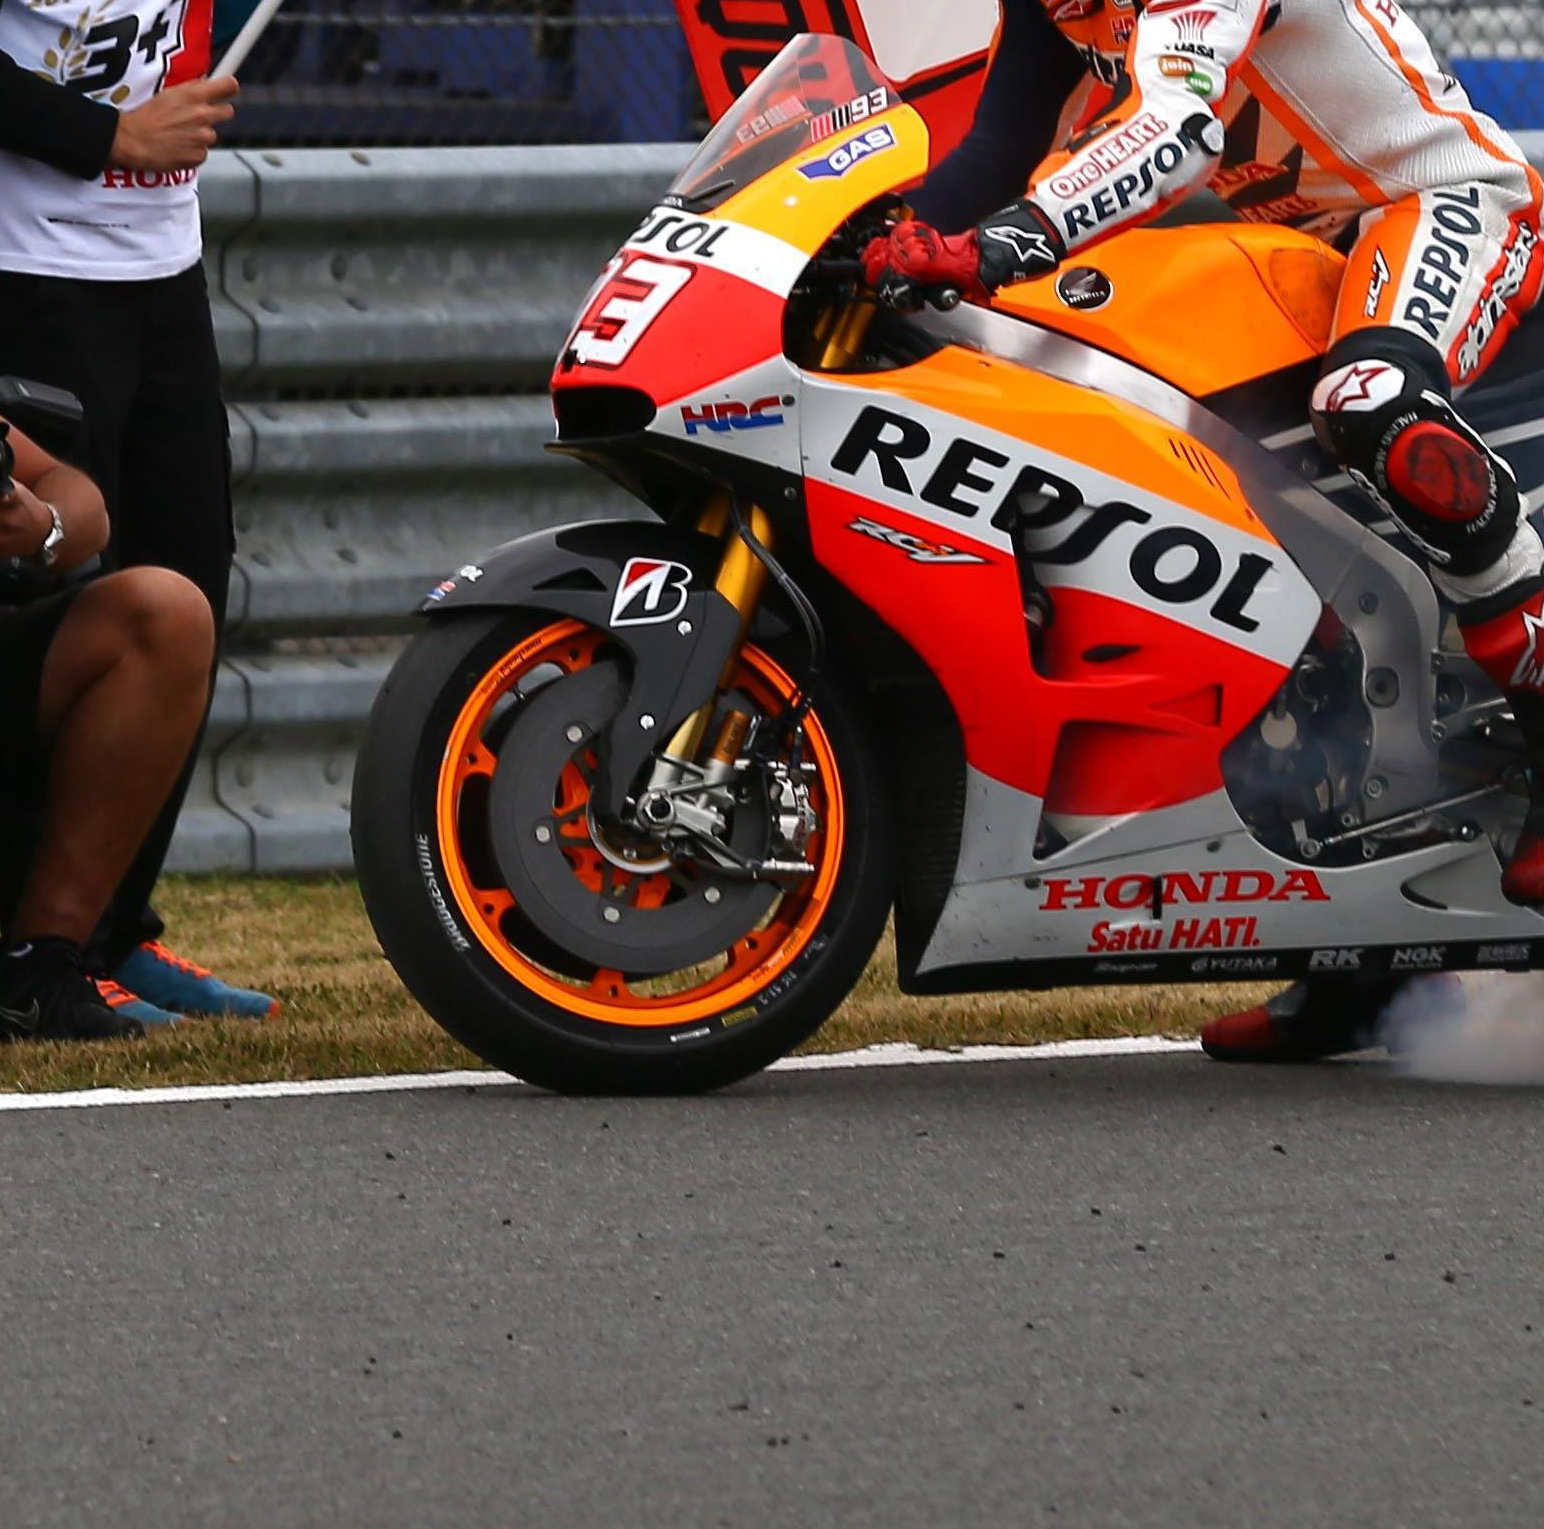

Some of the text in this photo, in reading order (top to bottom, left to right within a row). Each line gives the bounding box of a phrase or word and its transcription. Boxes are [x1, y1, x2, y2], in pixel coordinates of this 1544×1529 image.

[1165, 41, 1217, 61] UASA
[827, 127, 895, 173] GAS
[1050, 159, 1100, 199] One
[629, 214, 729, 258] SOL
[1404, 187, 1482, 341] REPSOL
[567, 256, 698, 368] 3
[680, 394, 786, 436] HRC
[830, 404, 1274, 633] REPSOL
[1038, 869, 1331, 911] HONDA
[1087, 920, 1163, 953] Satu
[1392, 946, 1447, 964] NGK
[1210, 956, 1278, 972] YUTAKA
[1309, 948, 1365, 968] RK
